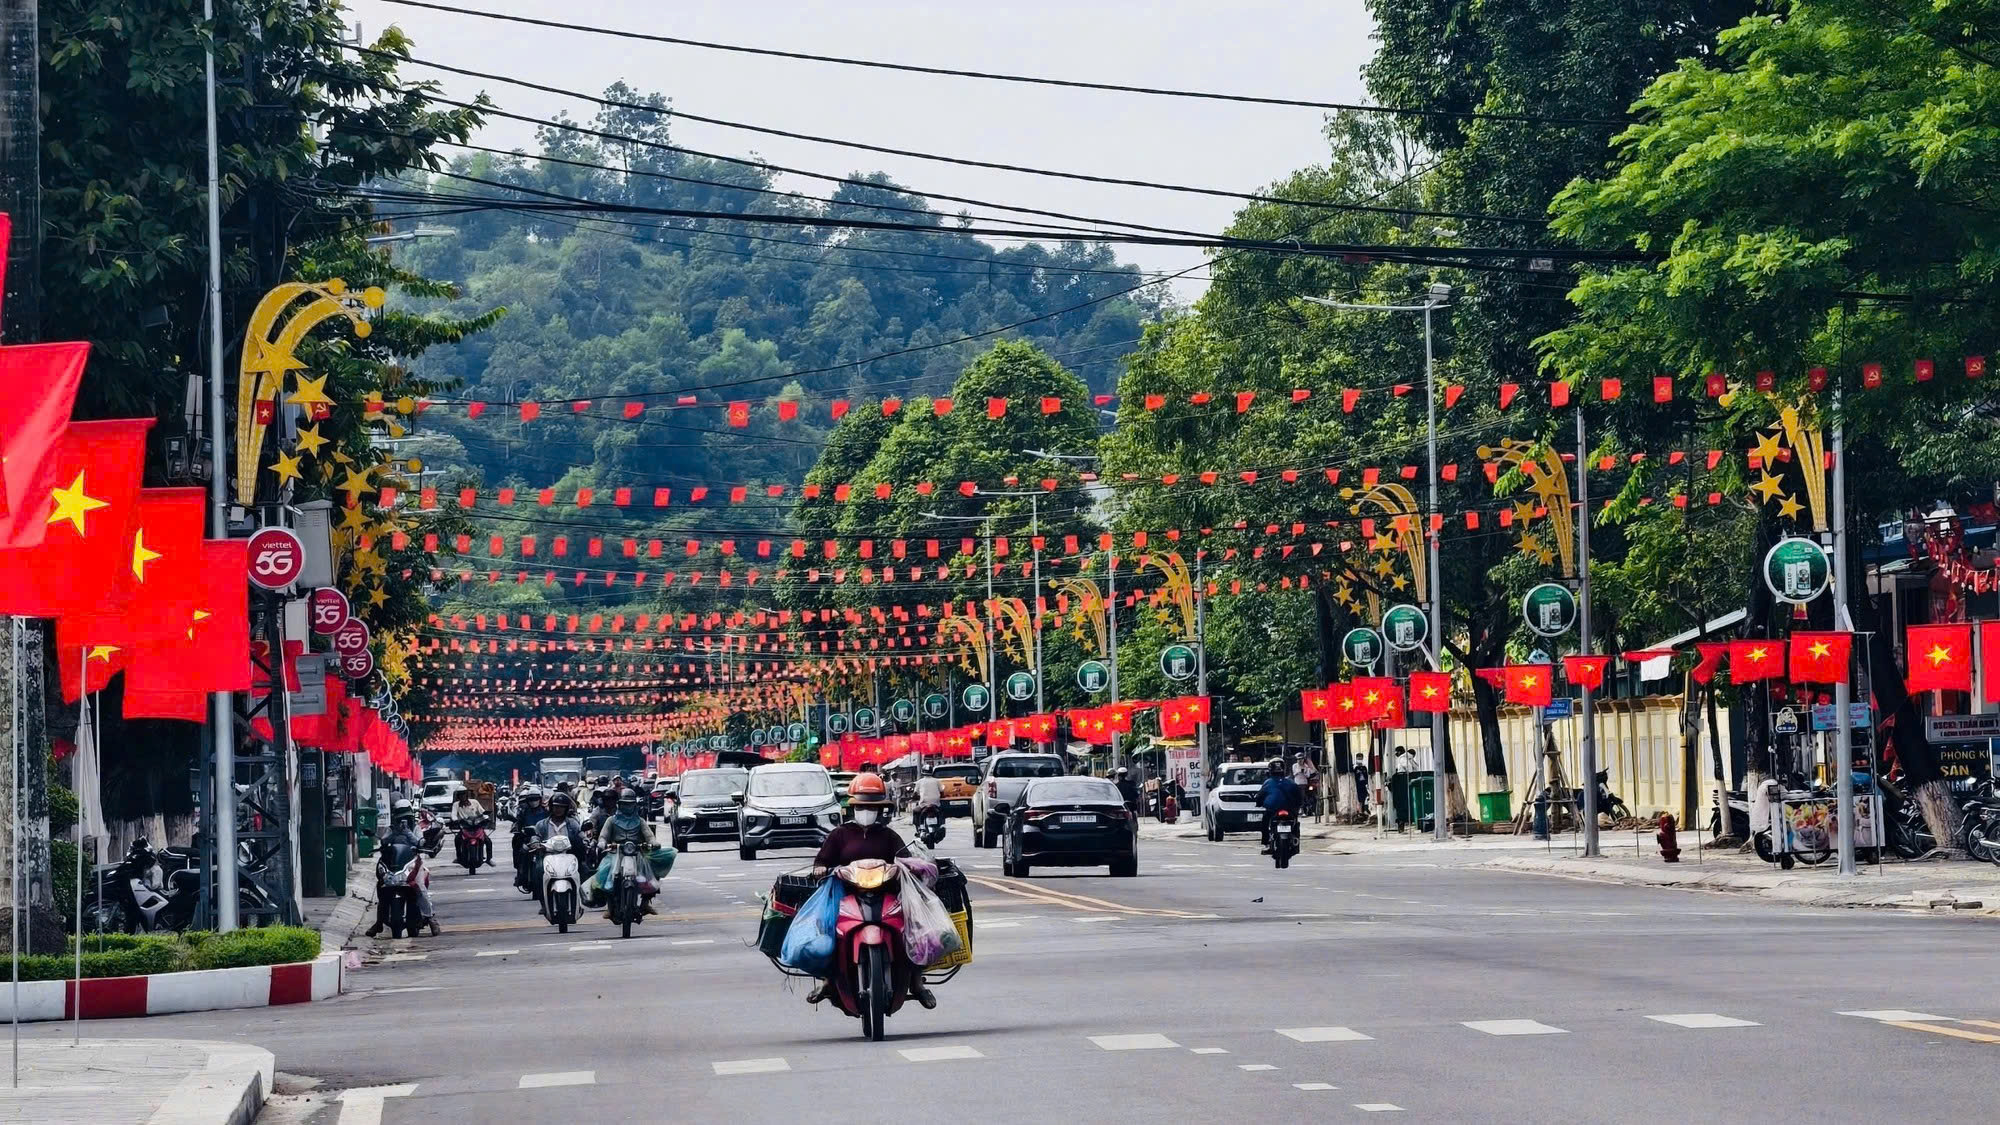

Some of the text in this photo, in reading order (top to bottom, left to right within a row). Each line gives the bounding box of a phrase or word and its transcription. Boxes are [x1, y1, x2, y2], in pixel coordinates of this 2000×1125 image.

[262, 541, 292, 549] viettel
[255, 551, 293, 575] 5G
[315, 605, 340, 625] 5G
[338, 632, 363, 649] 5G
[346, 658, 367, 671] 5G
[1940, 749, 1976, 760] PHÒNG
